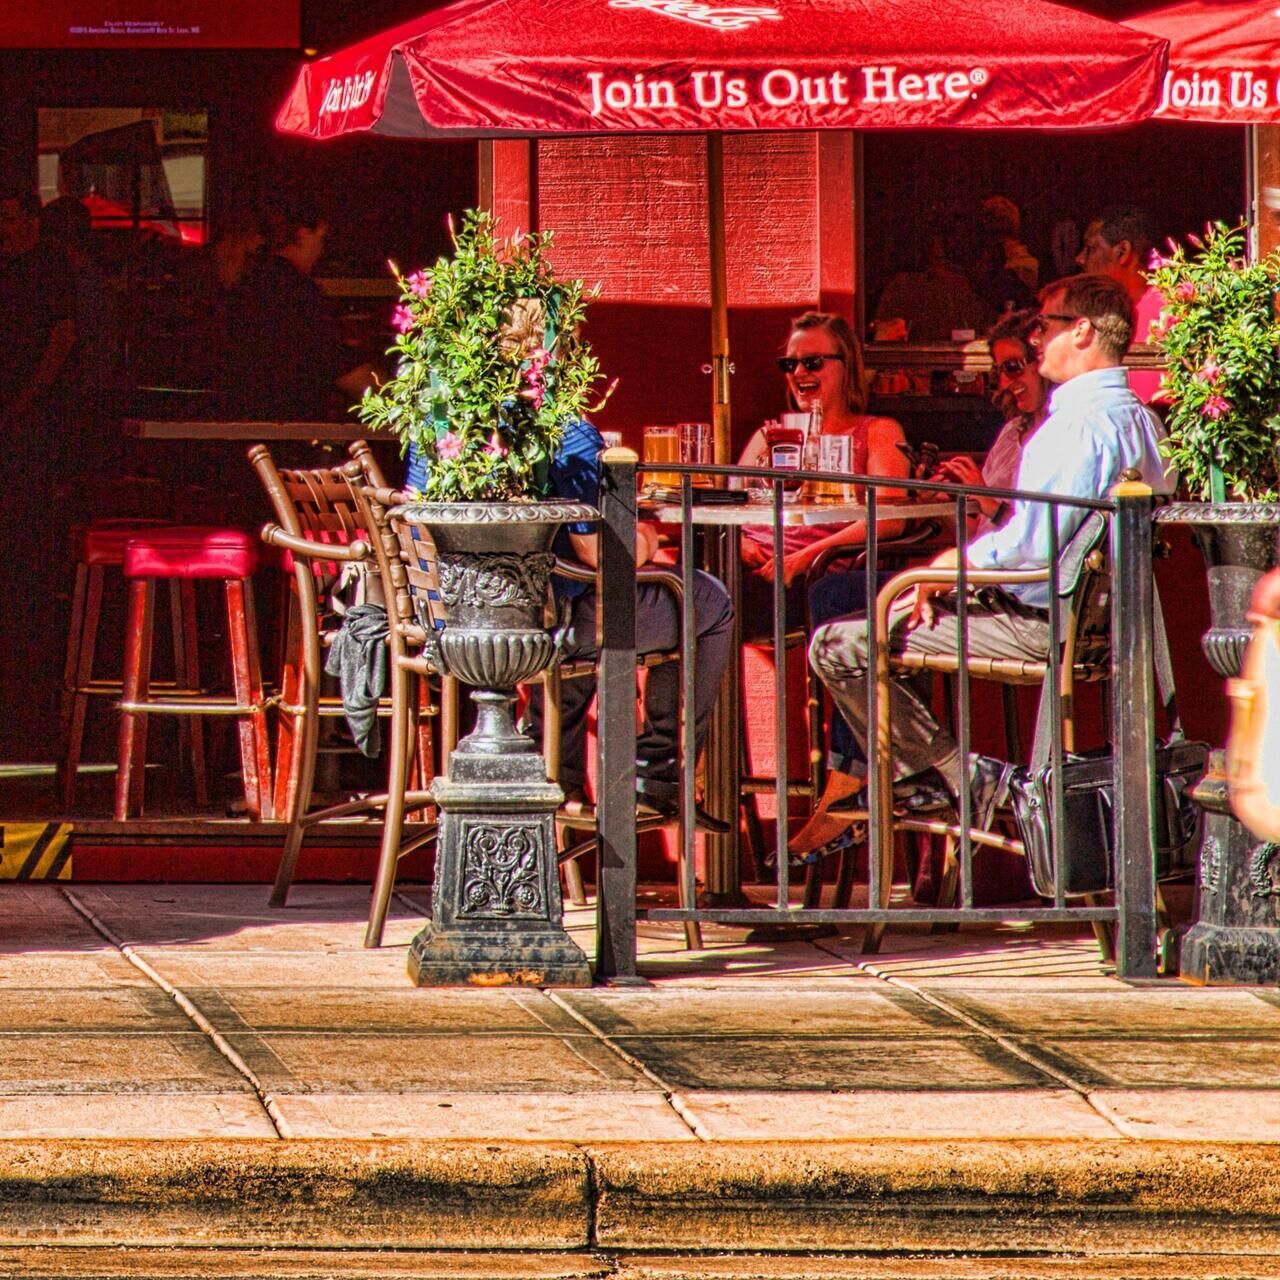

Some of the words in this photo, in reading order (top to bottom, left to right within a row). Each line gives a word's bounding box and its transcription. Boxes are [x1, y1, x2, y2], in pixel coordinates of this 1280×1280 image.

[587, 71, 678, 116] Join
[690, 69, 747, 108] Us
[760, 68, 848, 106] Out
[1153, 70, 1221, 115] Join
[1230, 71, 1268, 109] Us
